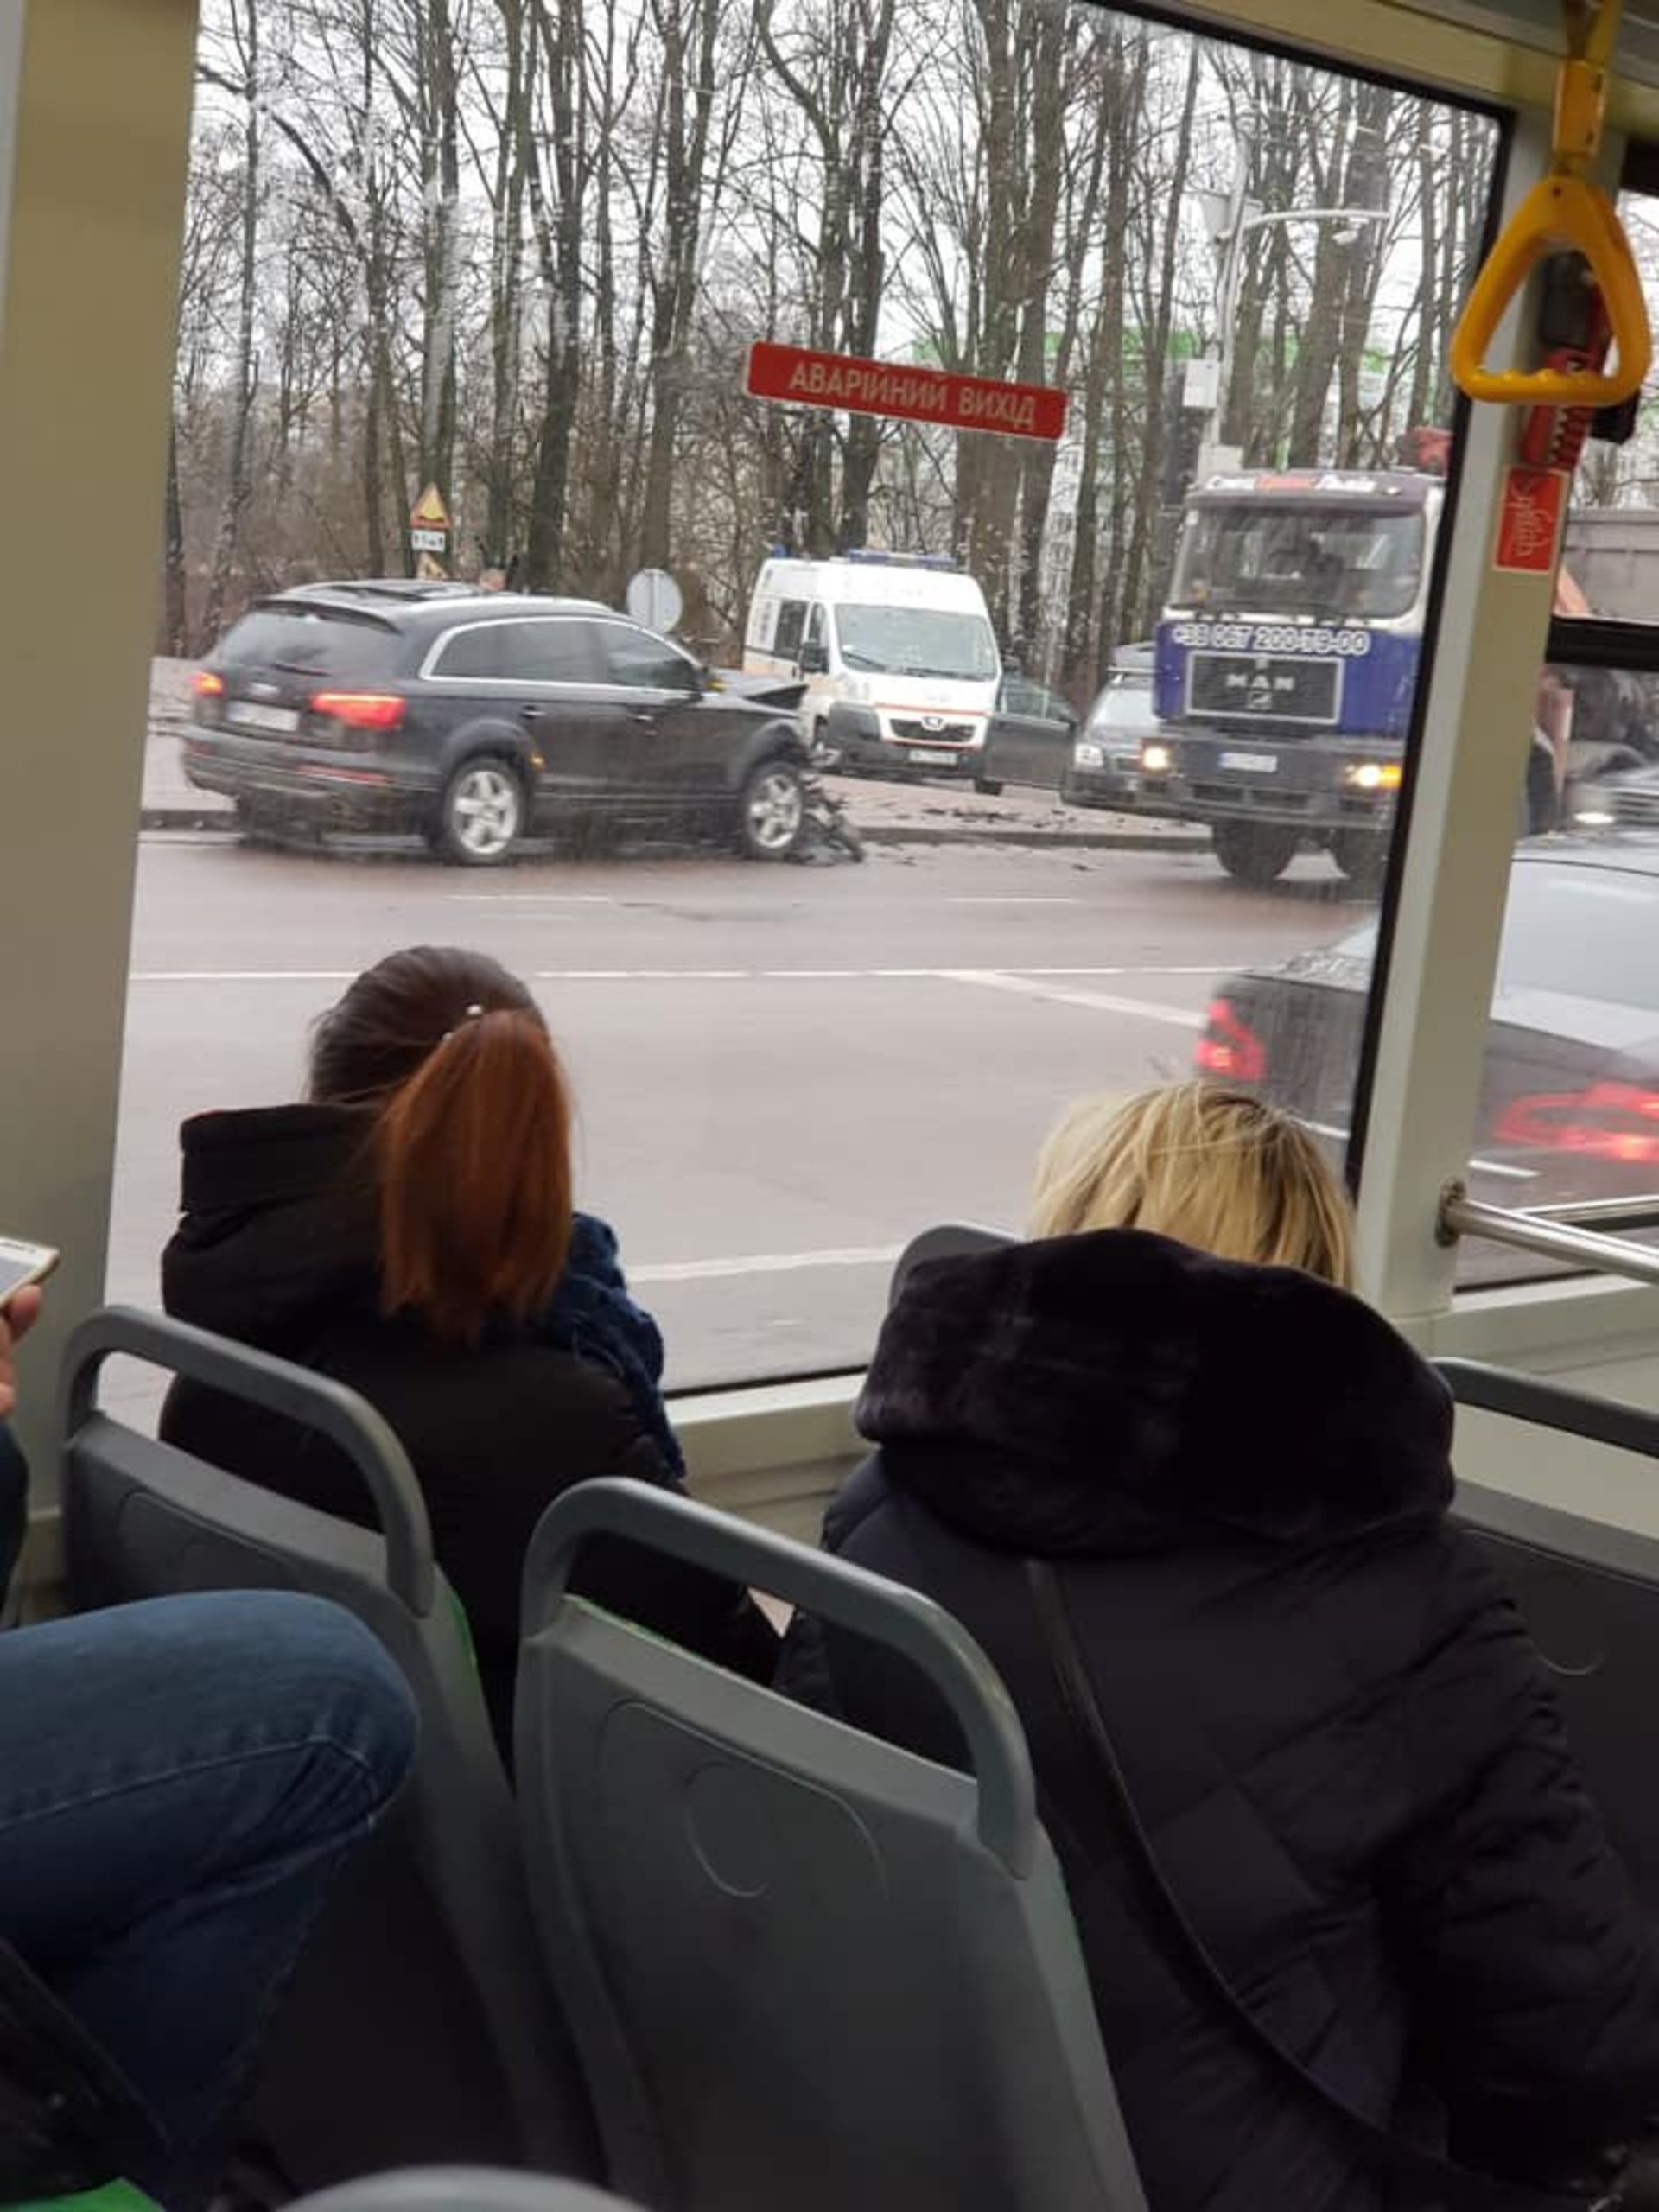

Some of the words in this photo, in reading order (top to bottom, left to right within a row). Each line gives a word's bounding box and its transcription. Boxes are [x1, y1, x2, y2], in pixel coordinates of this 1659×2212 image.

[788, 361, 947, 412] АВАРІЙНИЙ
[958, 386, 1035, 430] ВИХІД
[1225, 672, 1295, 691] MAN
